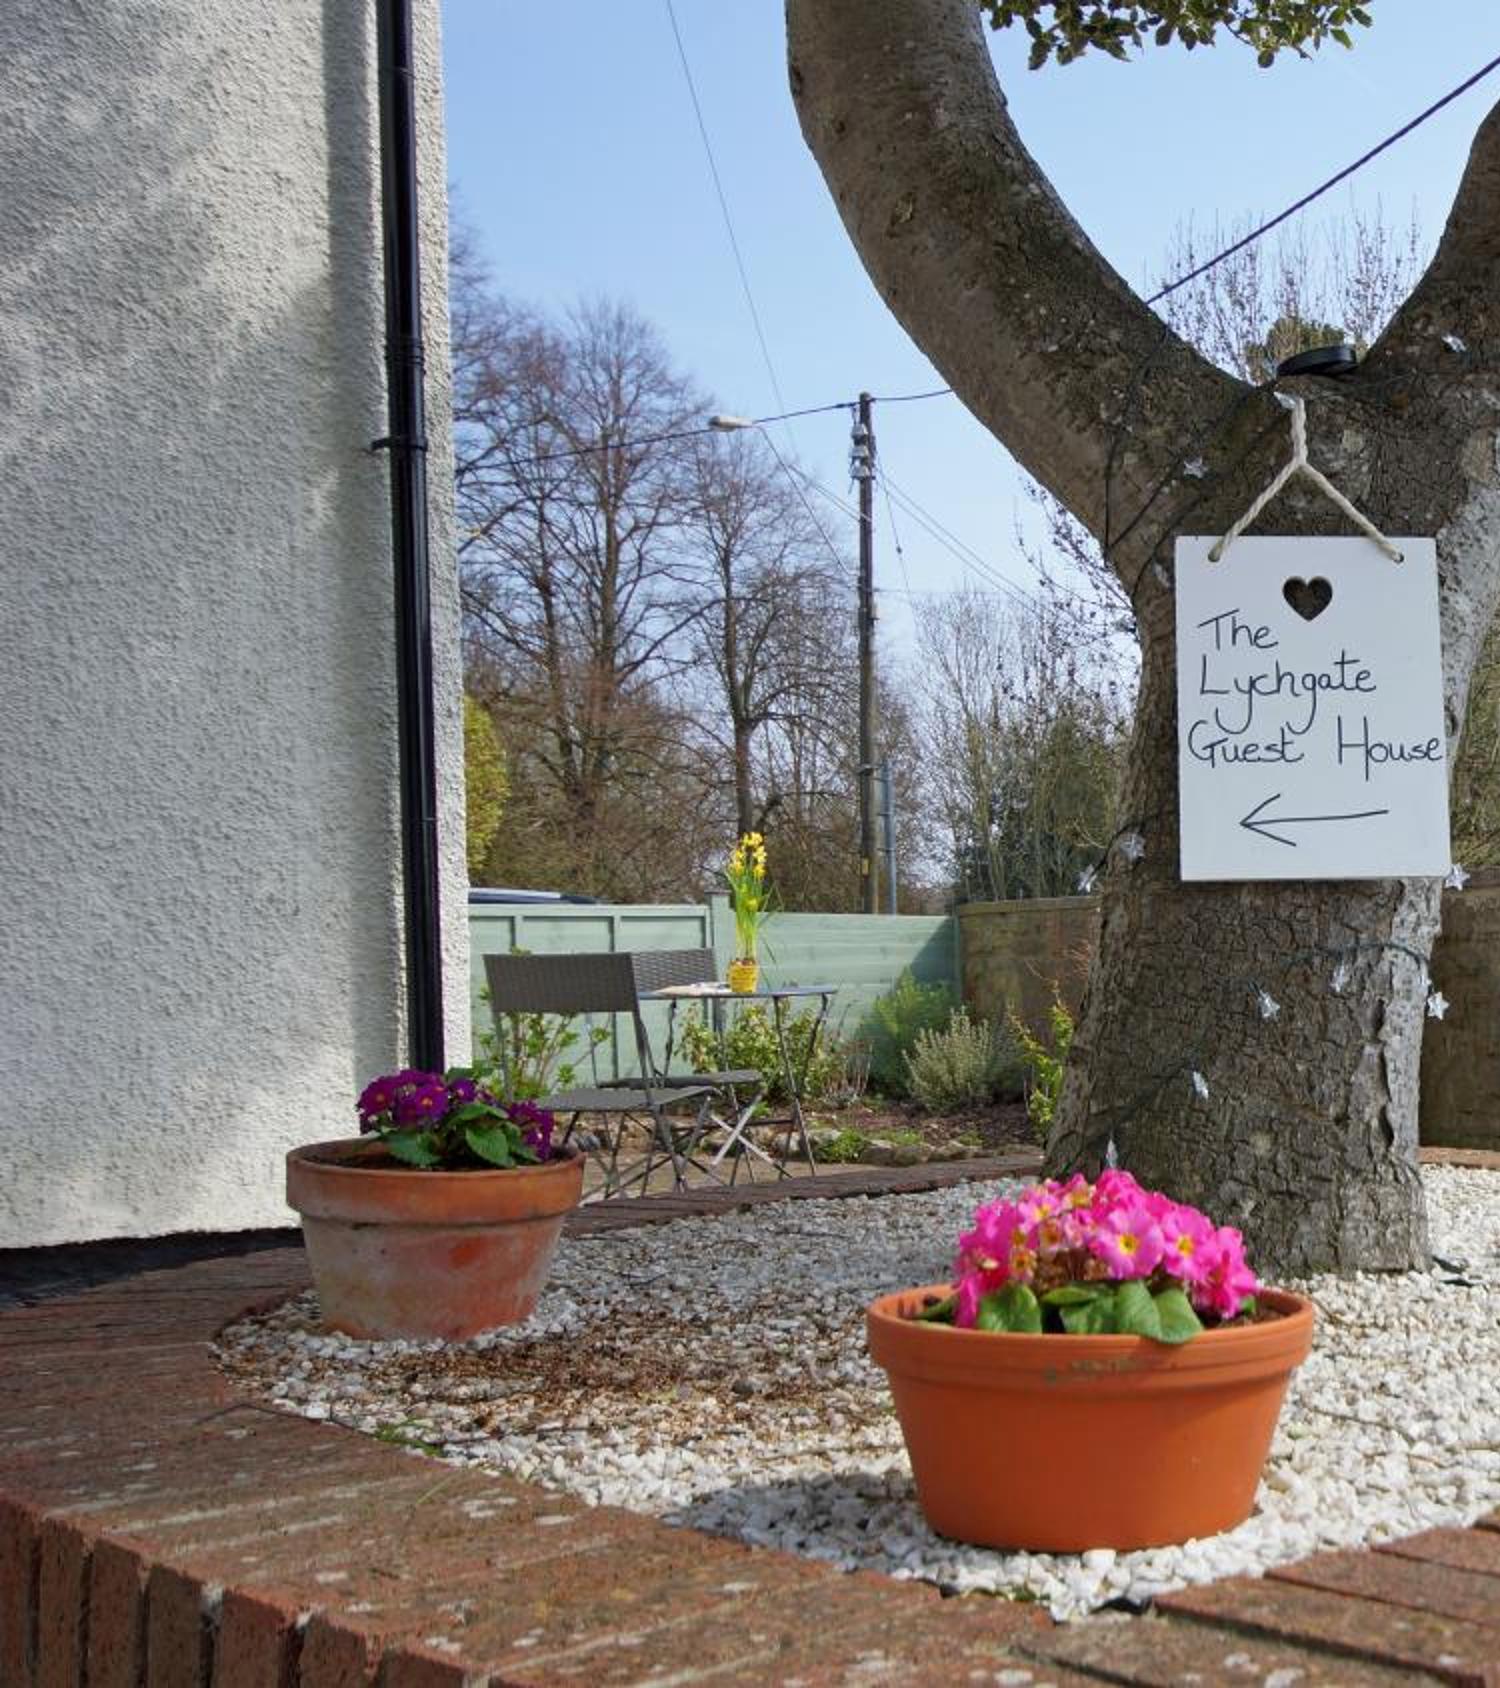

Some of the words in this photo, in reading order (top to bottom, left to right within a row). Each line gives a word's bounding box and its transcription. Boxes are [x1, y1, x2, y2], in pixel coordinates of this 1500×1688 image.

[1197, 608, 1279, 650] The
[1200, 649, 1376, 734] Lychgate
[1188, 719, 1304, 768] Guest
[1337, 715, 1443, 782] House
